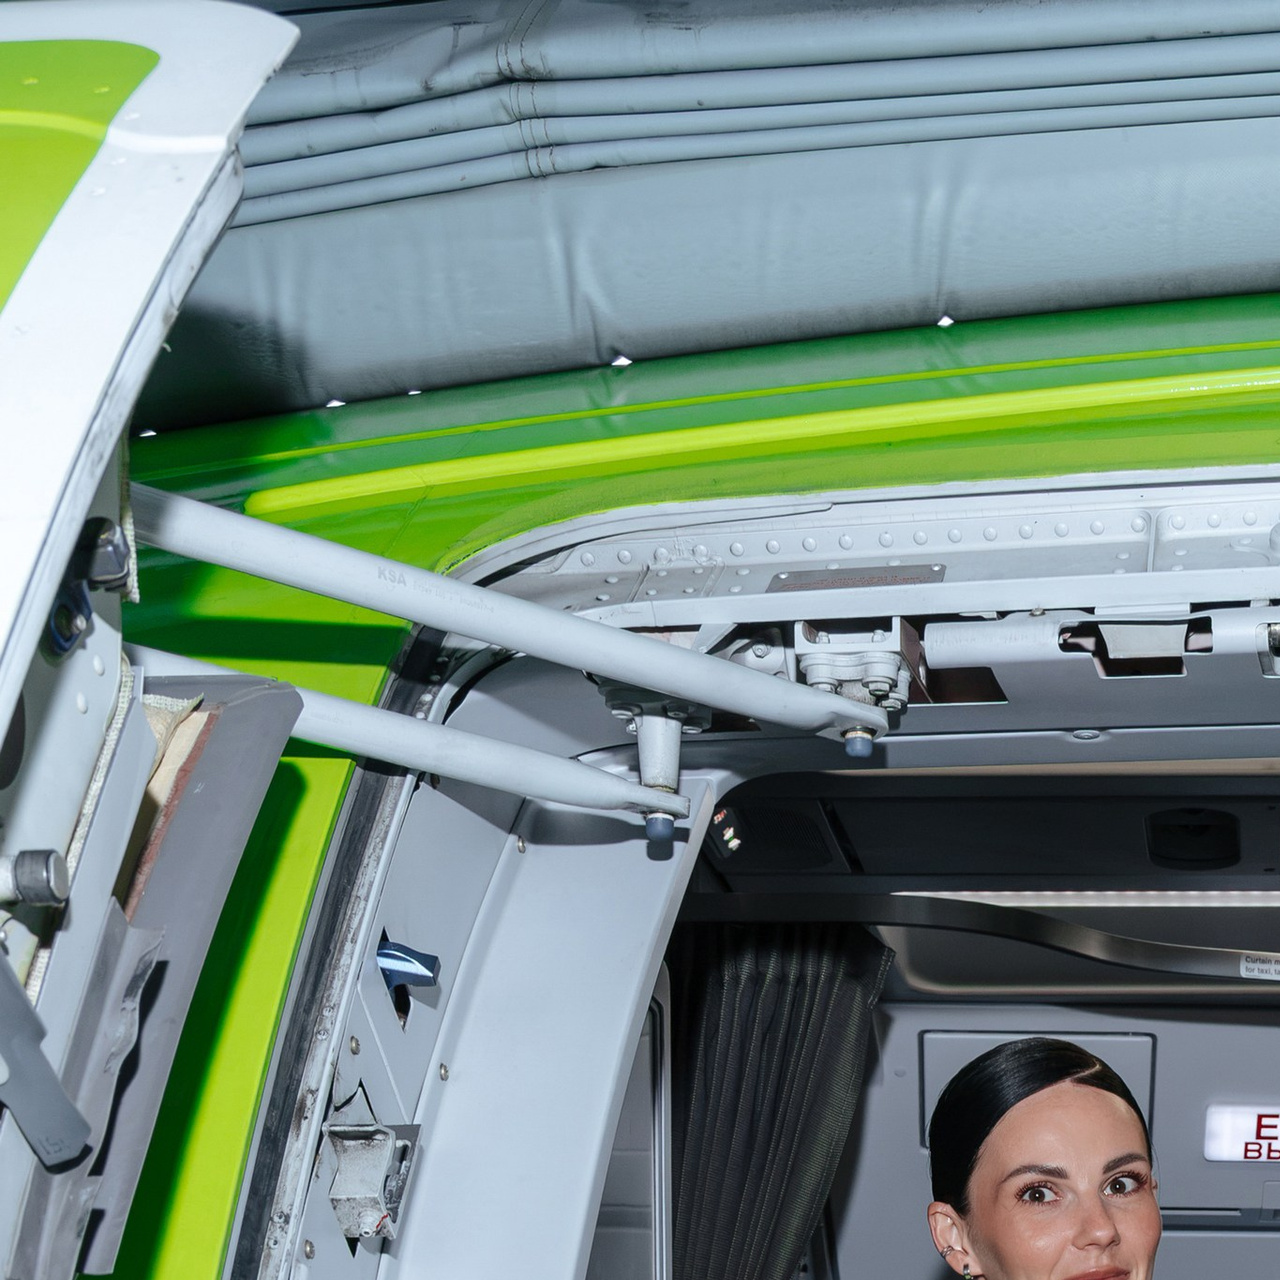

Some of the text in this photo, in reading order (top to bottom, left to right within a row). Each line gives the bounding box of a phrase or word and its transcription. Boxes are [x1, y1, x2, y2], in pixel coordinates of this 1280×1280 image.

[1245, 956, 1272, 965] Curtain
[1245, 966, 1256, 974] for
[1257, 967, 1273, 976] taxi,
